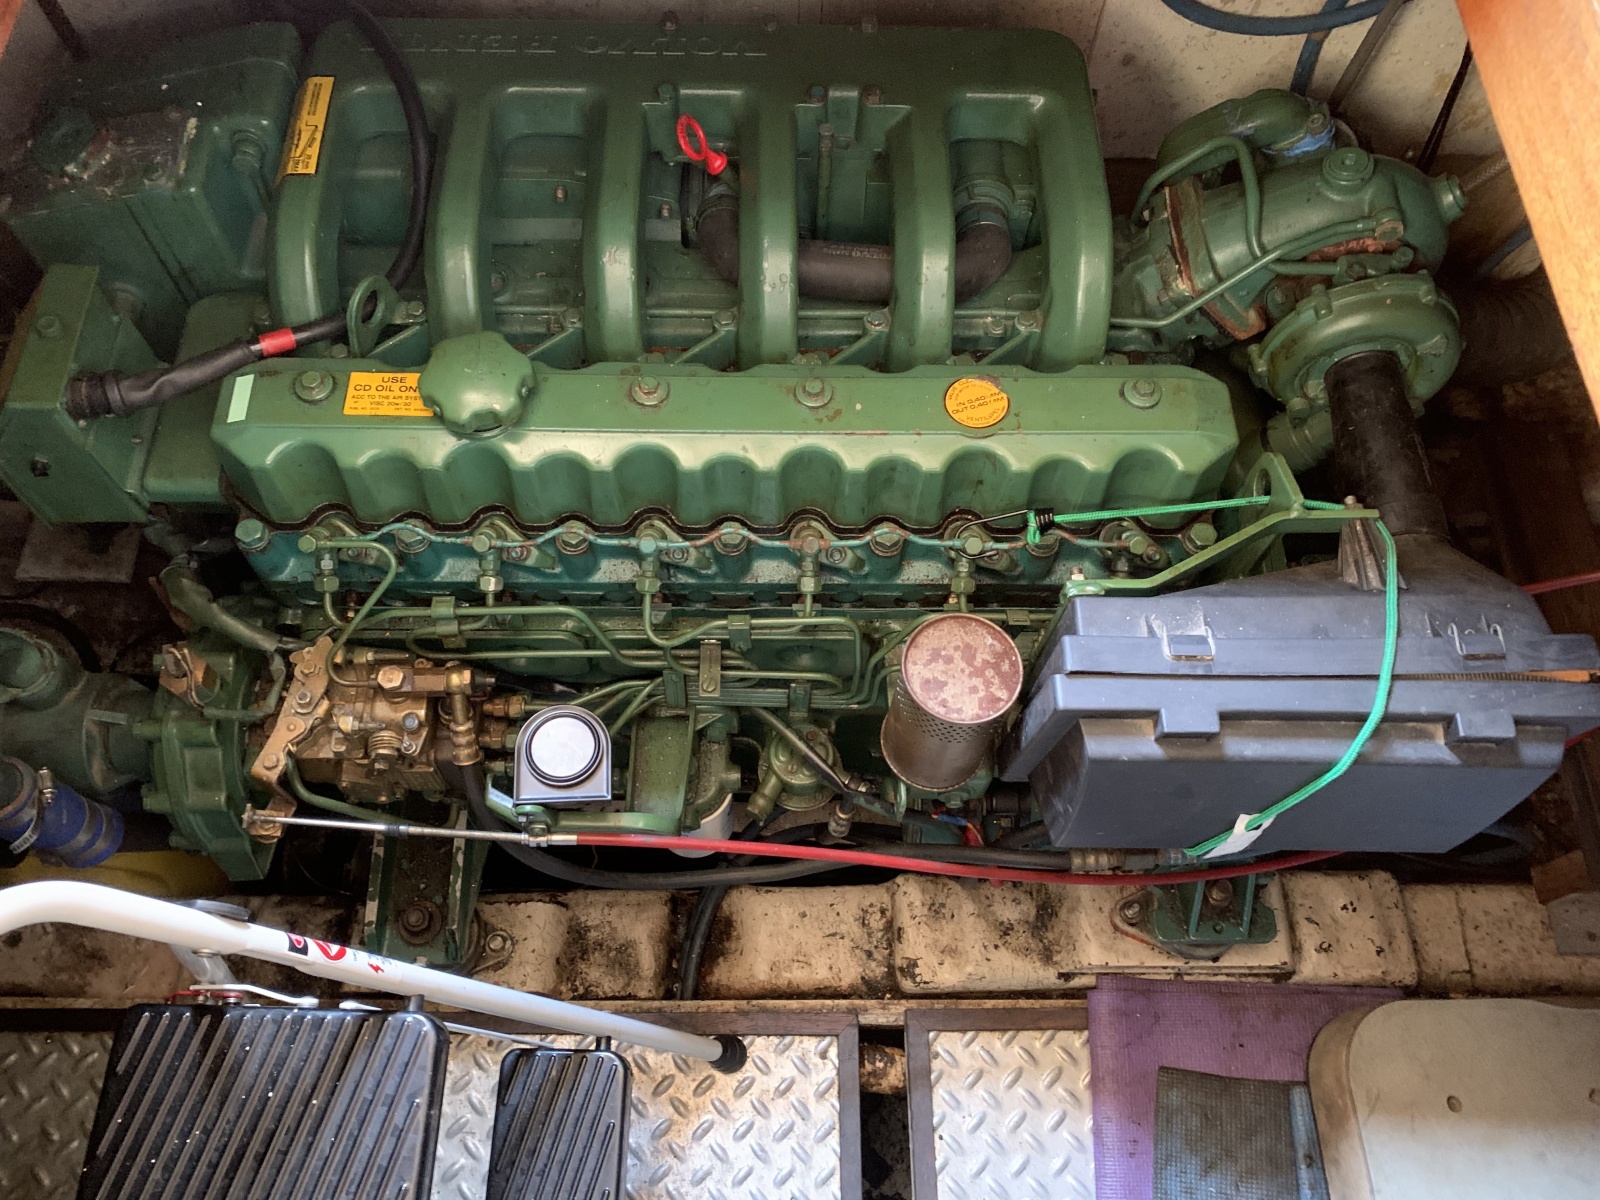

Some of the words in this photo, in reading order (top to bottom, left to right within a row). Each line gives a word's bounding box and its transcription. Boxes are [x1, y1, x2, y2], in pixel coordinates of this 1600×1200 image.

[381, 376, 408, 384] USE
[353, 384, 372, 392] CD
[375, 384, 395, 392] OIL
[398, 385, 418, 393] ON
[952, 406, 968, 415] OUT
